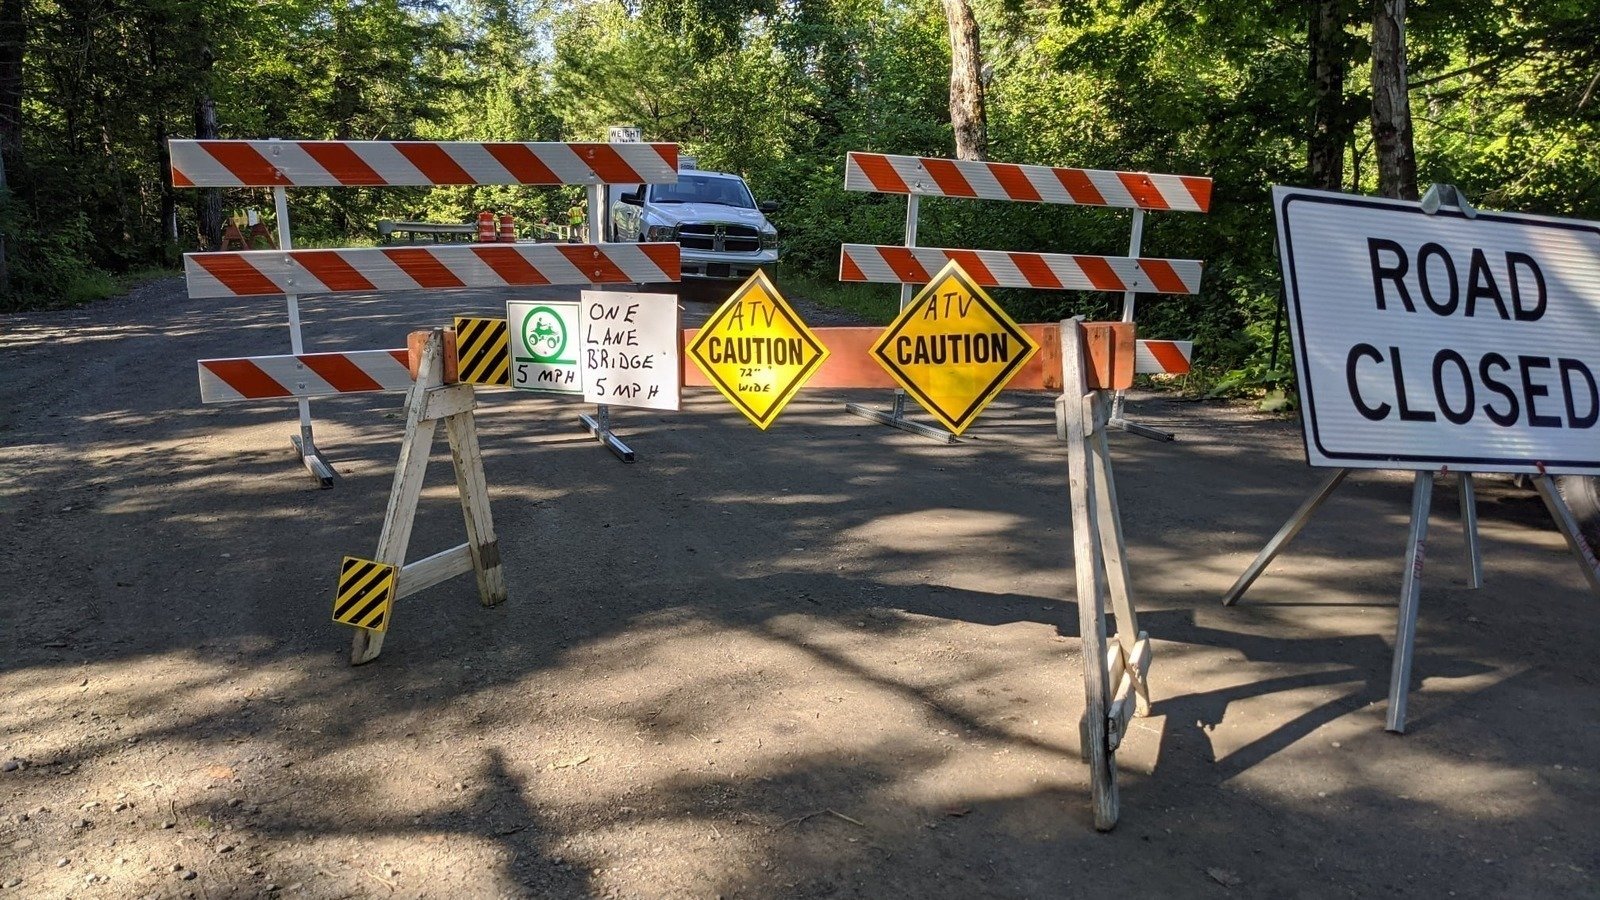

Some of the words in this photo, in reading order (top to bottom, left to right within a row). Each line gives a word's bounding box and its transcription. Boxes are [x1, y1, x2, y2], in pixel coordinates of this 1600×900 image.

[611, 130, 639, 138] WEIGHT
[1367, 237, 1547, 322] ROAD
[590, 303, 639, 323] ONE
[727, 301, 776, 331] ATV
[924, 292, 973, 320] ATV
[587, 324, 639, 346] LANE
[587, 349, 654, 370] BRIDGE
[709, 336, 803, 365] CAUTION
[896, 333, 1008, 365] CAUTION
[517, 365, 528, 383] 5
[538, 369, 575, 384] MPH
[1346, 343, 1600, 429] CLOSED
[596, 378, 607, 396] 5
[613, 383, 659, 399] MPH
